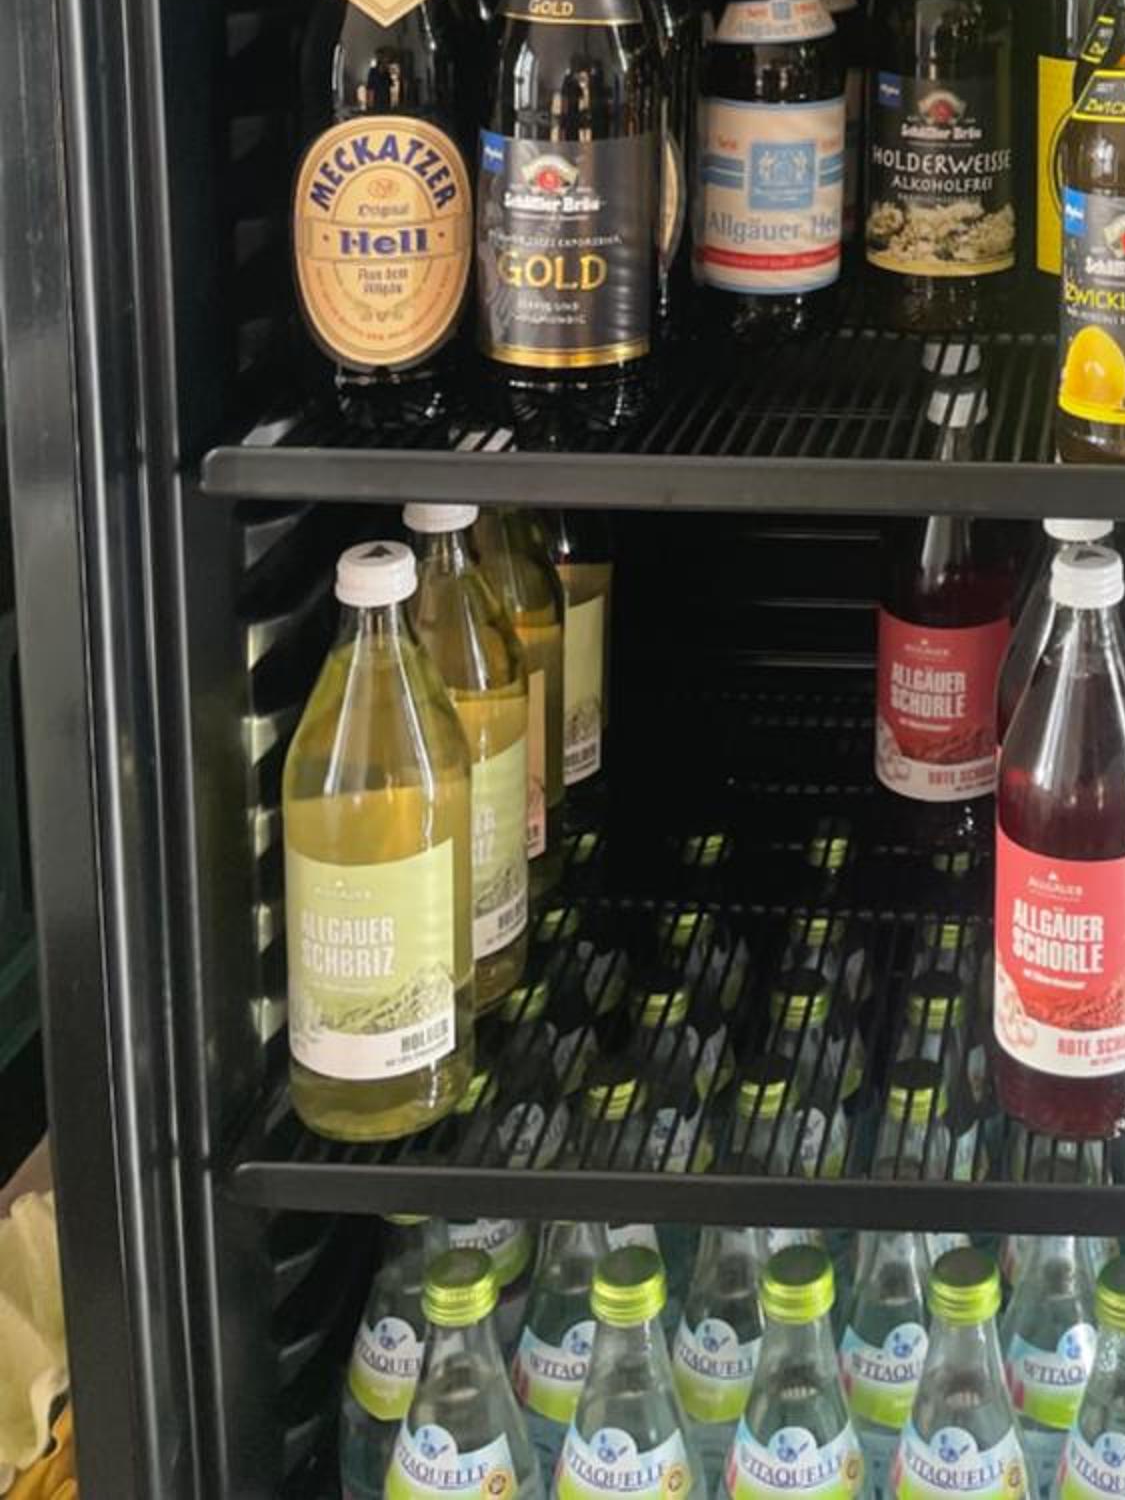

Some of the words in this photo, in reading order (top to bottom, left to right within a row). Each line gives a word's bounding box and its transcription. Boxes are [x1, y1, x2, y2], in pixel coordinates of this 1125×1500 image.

[309, 133, 457, 211] MECKATZER
[339, 228, 429, 256] Hell
[708, 211, 800, 245] Allgäuer
[497, 249, 608, 291] GOLD
[1012, 898, 1105, 942] ALLGÄUER
[1012, 925, 1105, 973] SCHORLE
